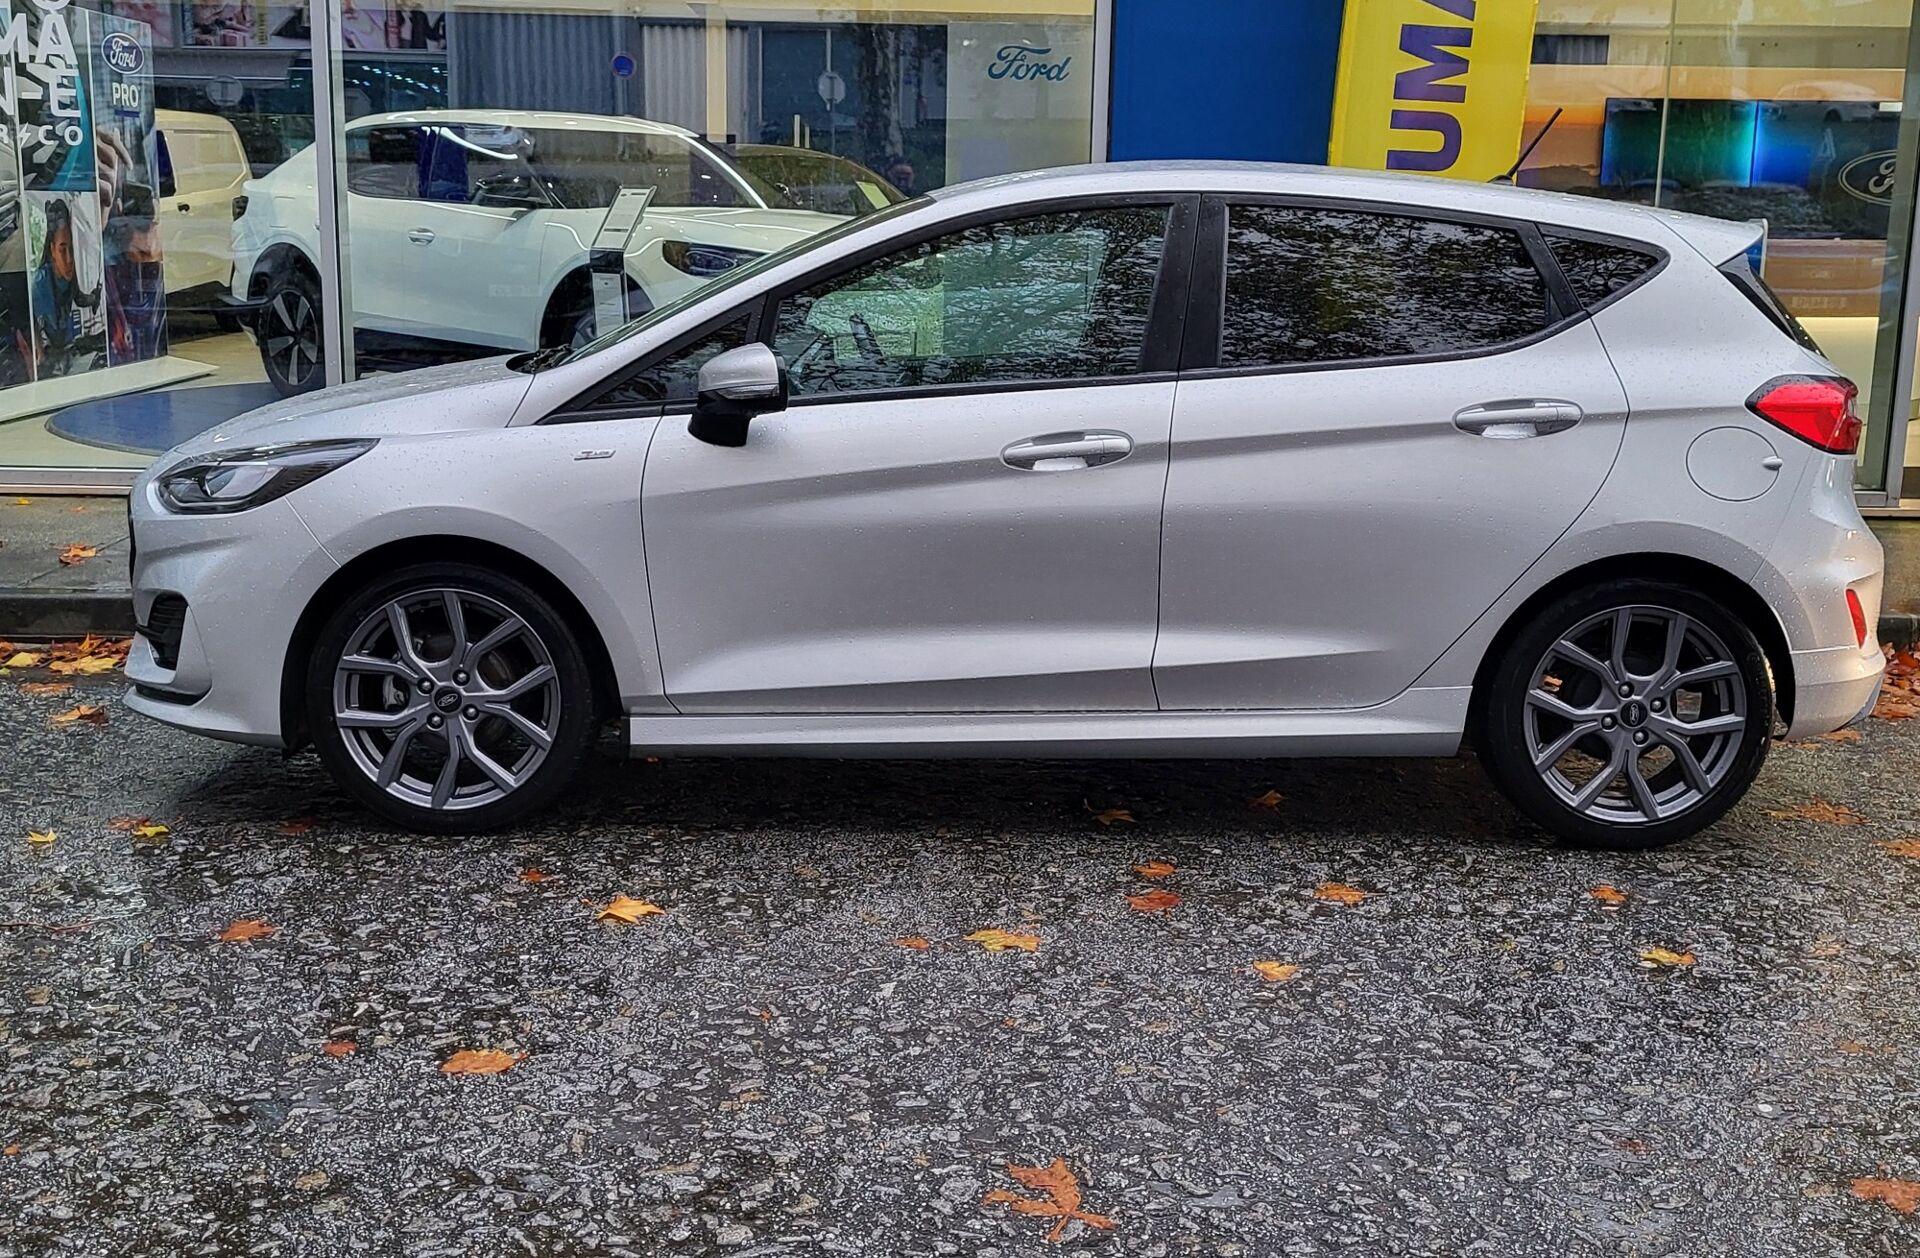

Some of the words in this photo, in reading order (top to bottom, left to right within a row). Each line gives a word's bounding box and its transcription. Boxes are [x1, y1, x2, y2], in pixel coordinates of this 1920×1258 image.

[109, 36, 138, 69] Ford
[987, 45, 1072, 81] Ford
[112, 82, 139, 107] PRO
[1386, 0, 1476, 172] UM
